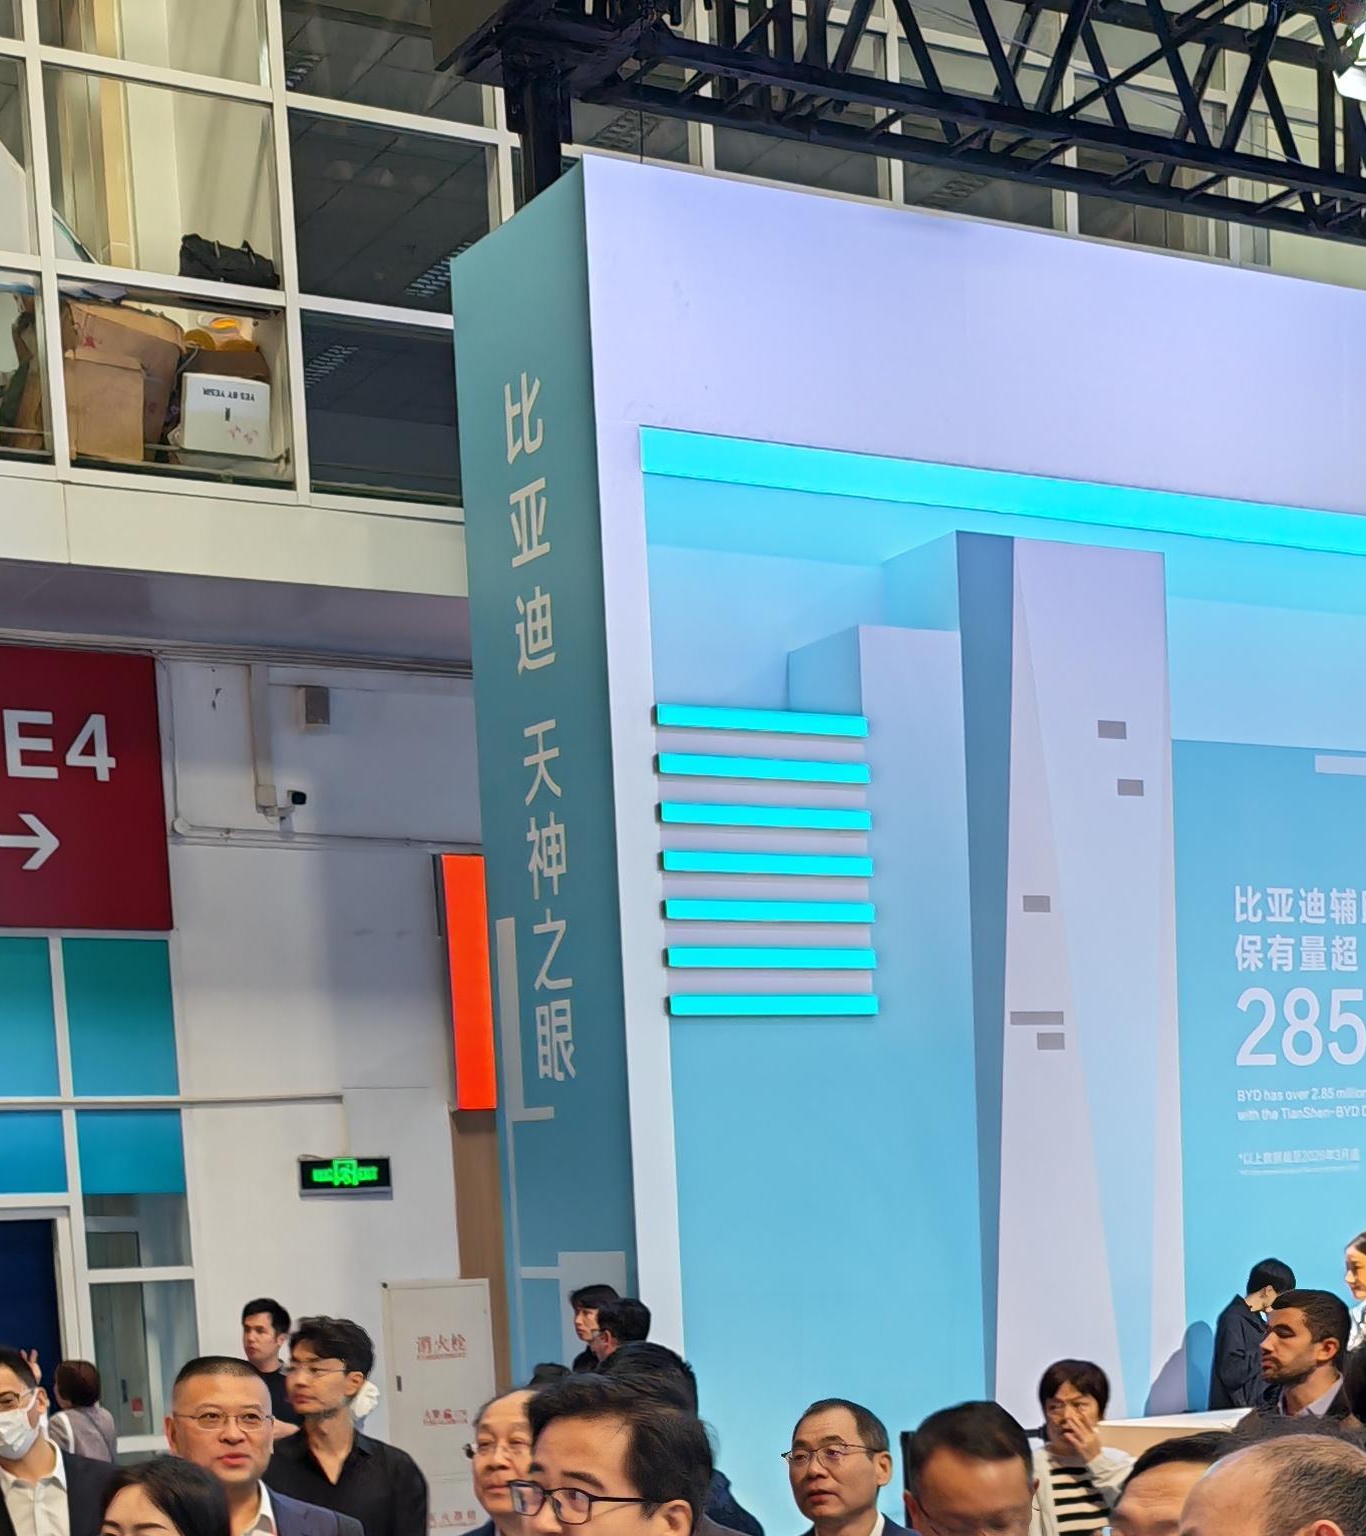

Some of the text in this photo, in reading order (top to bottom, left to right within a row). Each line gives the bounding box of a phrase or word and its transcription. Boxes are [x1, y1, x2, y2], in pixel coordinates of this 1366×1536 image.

[1, 708, 117, 782] E4
[504, 371, 578, 1082] 比亚迪 天神之眼
[1234, 934, 1360, 973] 保有量超
